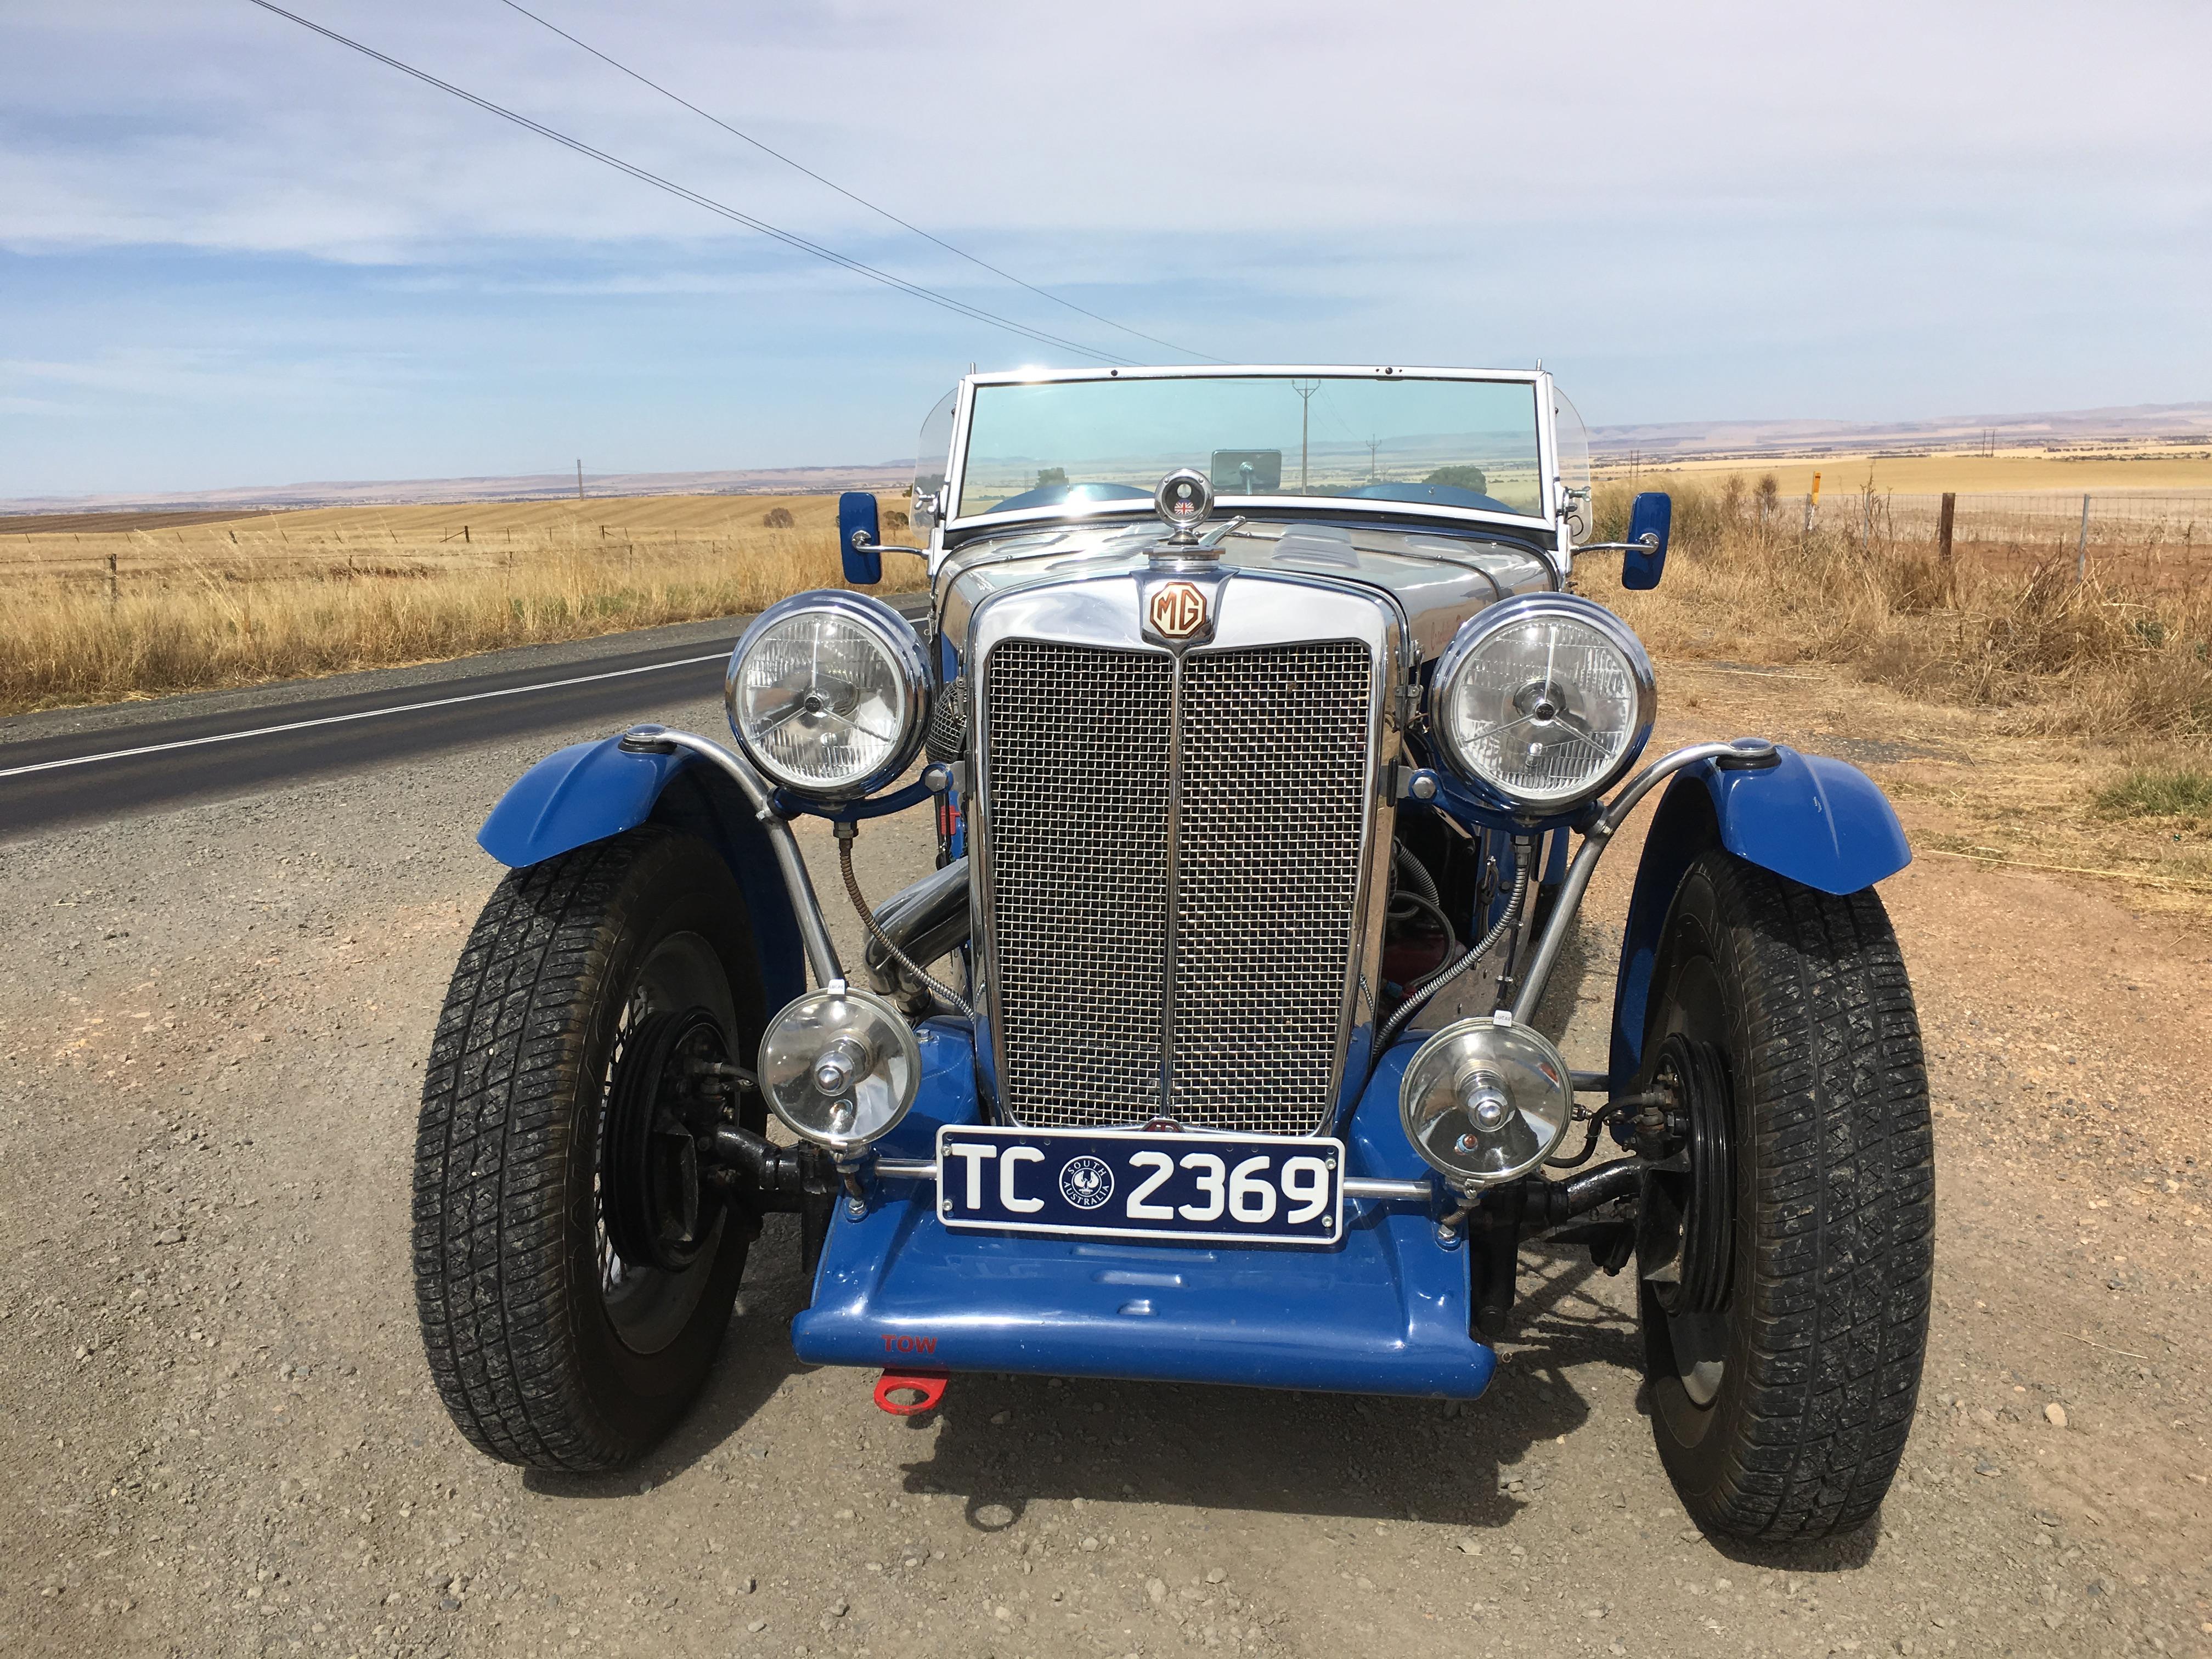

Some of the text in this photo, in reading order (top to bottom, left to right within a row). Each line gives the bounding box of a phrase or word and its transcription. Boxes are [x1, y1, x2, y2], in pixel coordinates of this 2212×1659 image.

[1157, 590, 1199, 630] MG
[1068, 1160, 1107, 1176] SOUTH
[951, 1143, 1329, 1224] TC 2369
[1063, 1181, 1109, 1205] AUSTRALIA
[881, 1334, 938, 1354] TOW
